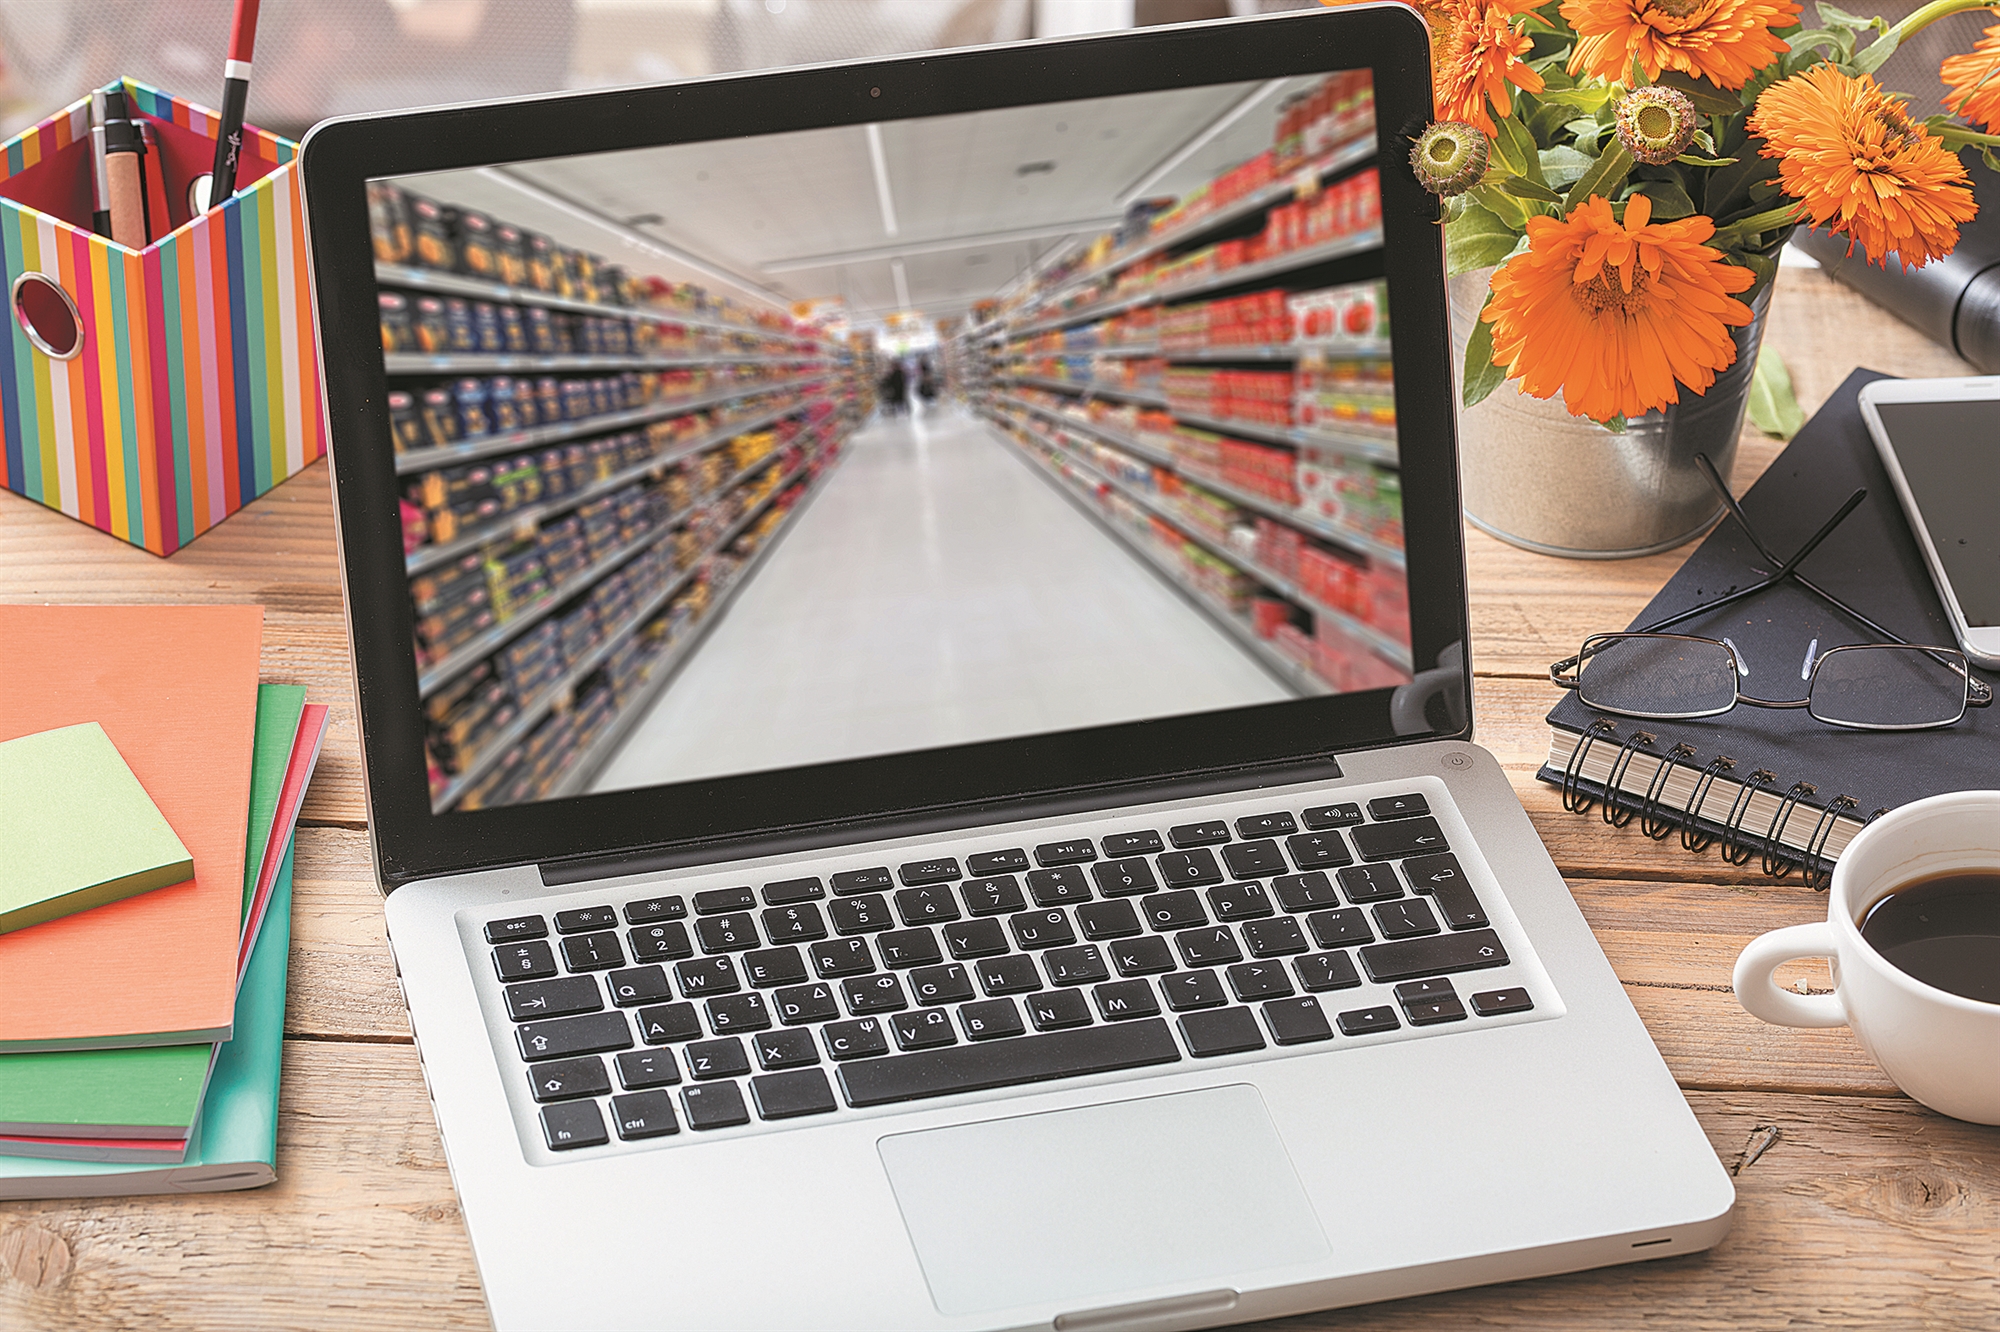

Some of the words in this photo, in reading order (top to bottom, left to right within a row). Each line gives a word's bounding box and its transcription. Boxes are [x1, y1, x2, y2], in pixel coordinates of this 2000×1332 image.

[1280, 820, 1293, 828] F11
[1212, 828, 1226, 836] F10
[1122, 875, 1133, 886] 9
[985, 882, 999, 892] &
[1056, 884, 1068, 895] 8
[850, 899, 867, 910] %
[989, 894, 1000, 905] 7
[925, 903, 936, 913] 6
[1220, 901, 1233, 912] P
[786, 908, 798, 920] $
[859, 912, 869, 923] 5
[1156, 910, 1172, 921] O
[506, 921, 527, 930] esc
[720, 918, 731, 929] #
[791, 921, 803, 932] 4
[650, 928, 664, 937] @
[724, 931, 736, 942] 3
[1022, 928, 1038, 940] U
[656, 940, 669, 951] 2
[955, 937, 968, 949] Y
[589, 950, 599, 960] 1
[888, 947, 900, 958] T
[1188, 947, 1202, 958] L
[821, 957, 836, 969] R
[1122, 955, 1138, 967] K
[1318, 956, 1328, 967] ?
[754, 966, 766, 978] E
[1058, 965, 1067, 977] J
[686, 975, 705, 988] W
[988, 973, 1005, 986] H
[619, 985, 637, 997] Q
[921, 983, 937, 995] G
[853, 993, 864, 1005] F
[1108, 998, 1128, 1011] M
[1301, 999, 1314, 1008] alt
[784, 1003, 800, 1015] D
[1038, 1008, 1056, 1021] N
[717, 1013, 730, 1025] S
[650, 1022, 665, 1035] A
[970, 1019, 985, 1031] B
[902, 1028, 916, 1040] V
[834, 1038, 850, 1050] C
[765, 1047, 782, 1060] X
[696, 1057, 712, 1071] Z
[687, 1088, 702, 1097] alt
[624, 1118, 645, 1130] ctrl
[558, 1130, 571, 1140] fn
